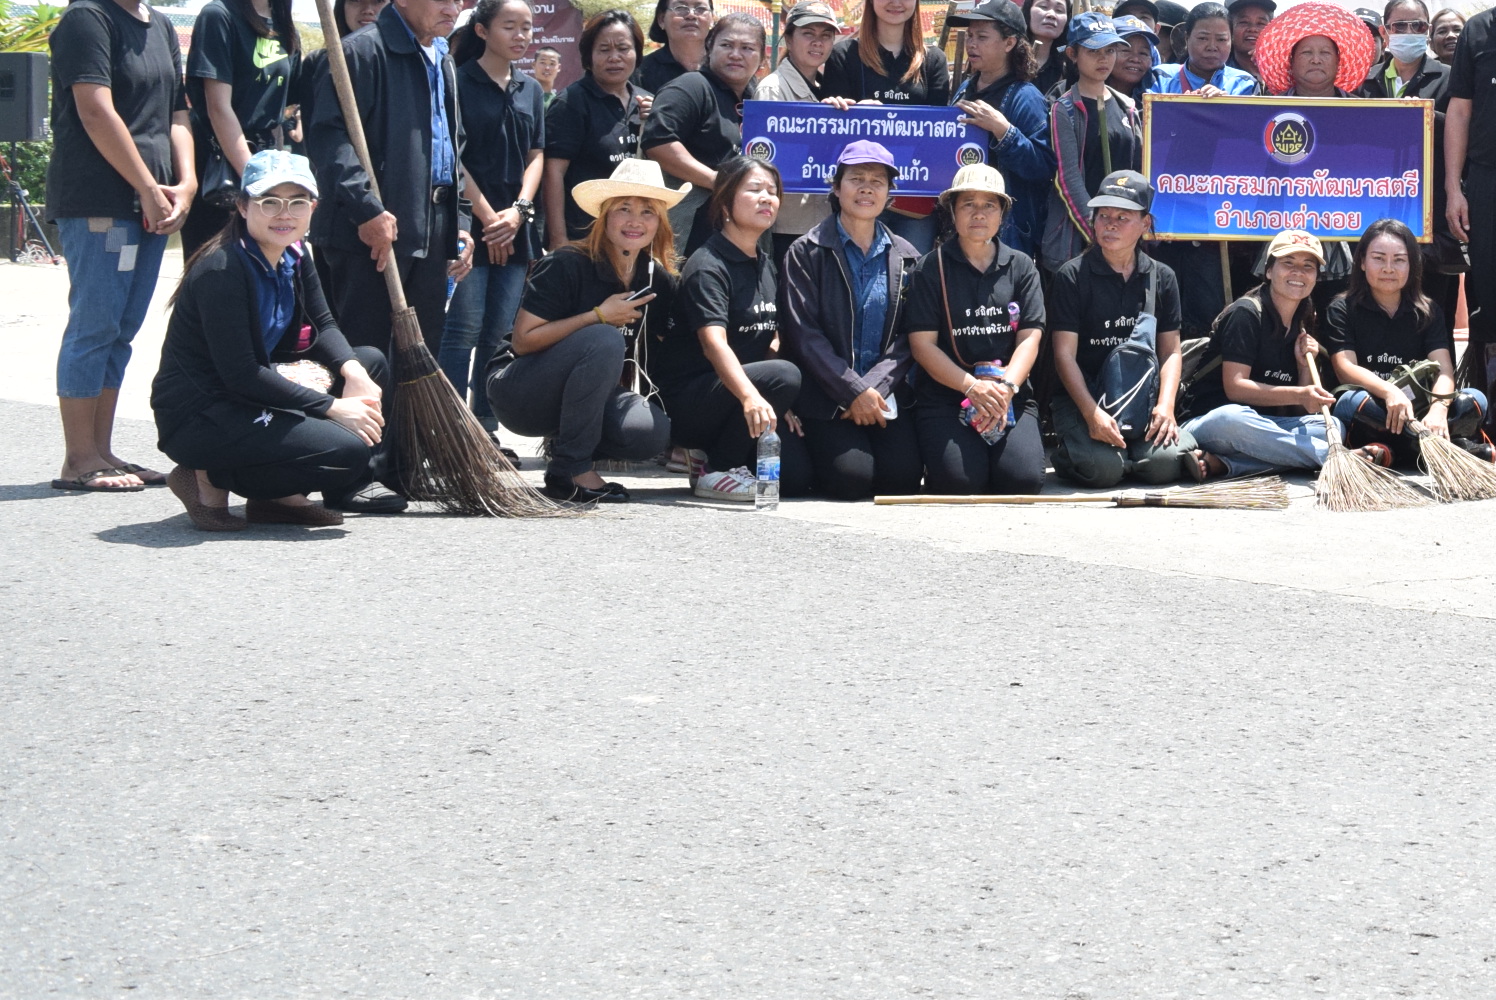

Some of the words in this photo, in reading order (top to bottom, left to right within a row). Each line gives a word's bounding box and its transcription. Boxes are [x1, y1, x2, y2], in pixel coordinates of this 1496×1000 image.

[766, 112, 967, 139] คณะกรรมการพัฒนาสตรี
[1157, 168, 1420, 199] คณะกรรมการพัฒนาสตรี
[1215, 201, 1362, 230] อำเภอเต่างอย
